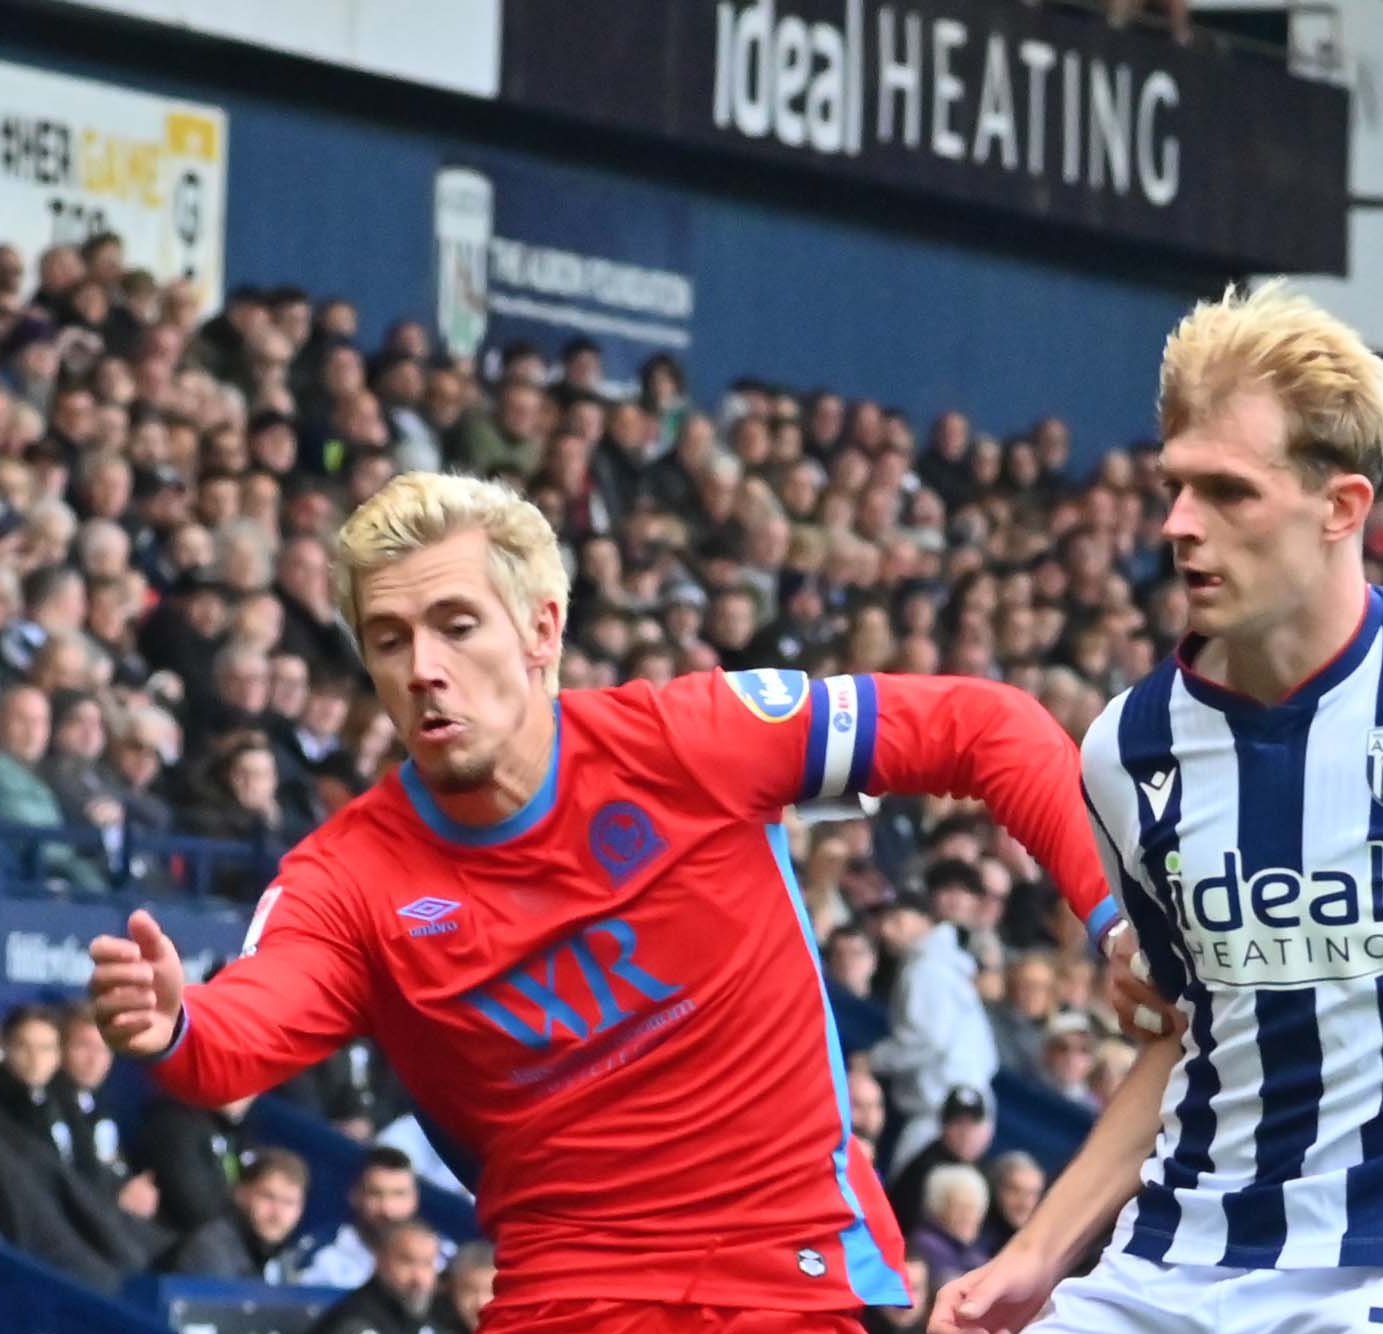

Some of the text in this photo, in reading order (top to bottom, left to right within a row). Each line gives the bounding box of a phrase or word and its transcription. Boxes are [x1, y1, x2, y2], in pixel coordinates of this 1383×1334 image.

[713, 0, 862, 157] ideal
[877, 7, 1180, 206] HEATING
[408, 918, 459, 938] umbro
[462, 917, 685, 1048] WR
